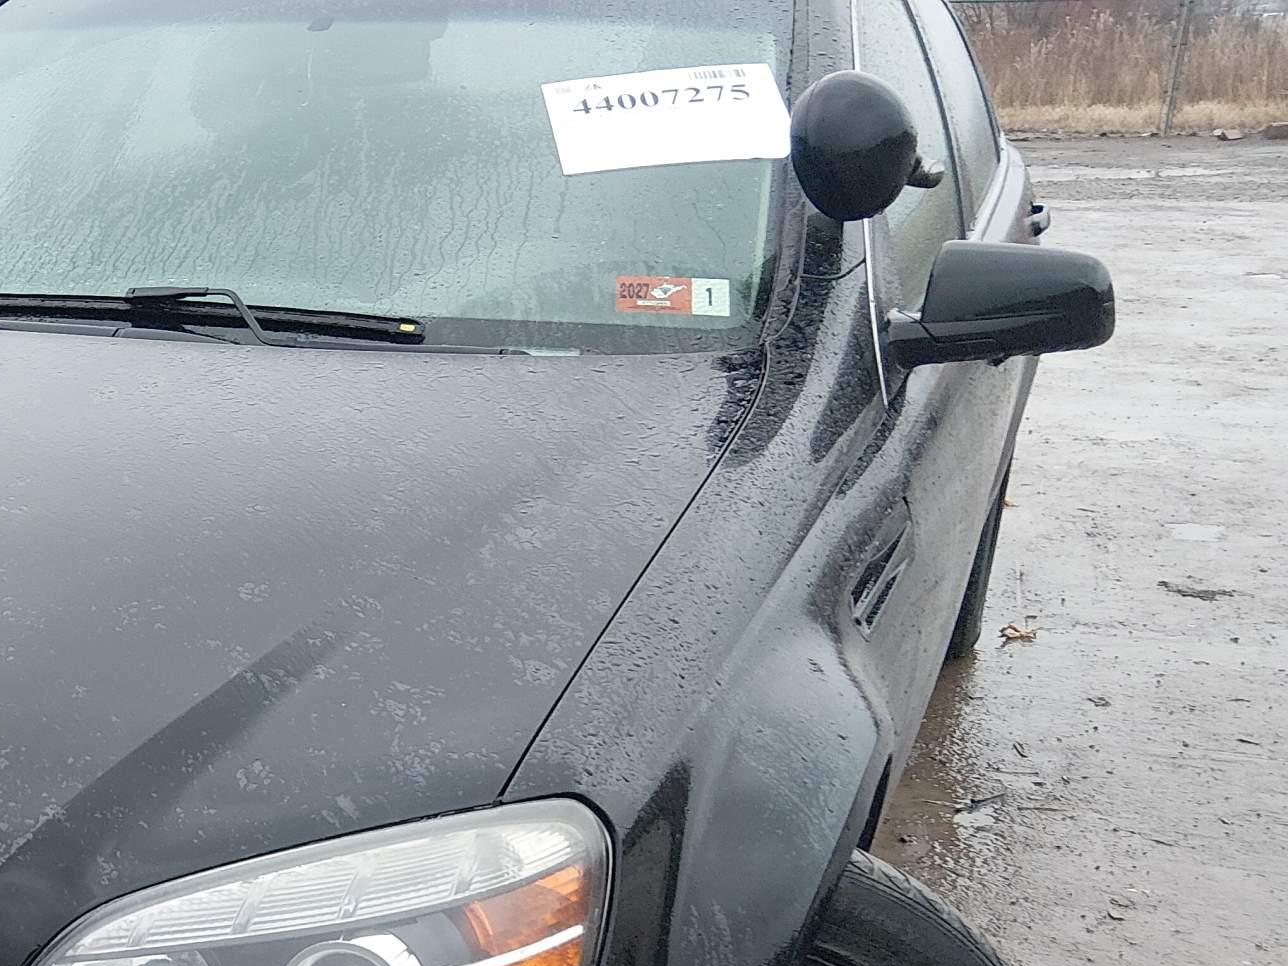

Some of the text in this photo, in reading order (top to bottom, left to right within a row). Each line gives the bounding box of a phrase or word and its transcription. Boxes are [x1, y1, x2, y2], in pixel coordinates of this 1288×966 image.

[573, 84, 750, 114] 44007275
[619, 283, 713, 307] 2027 1
